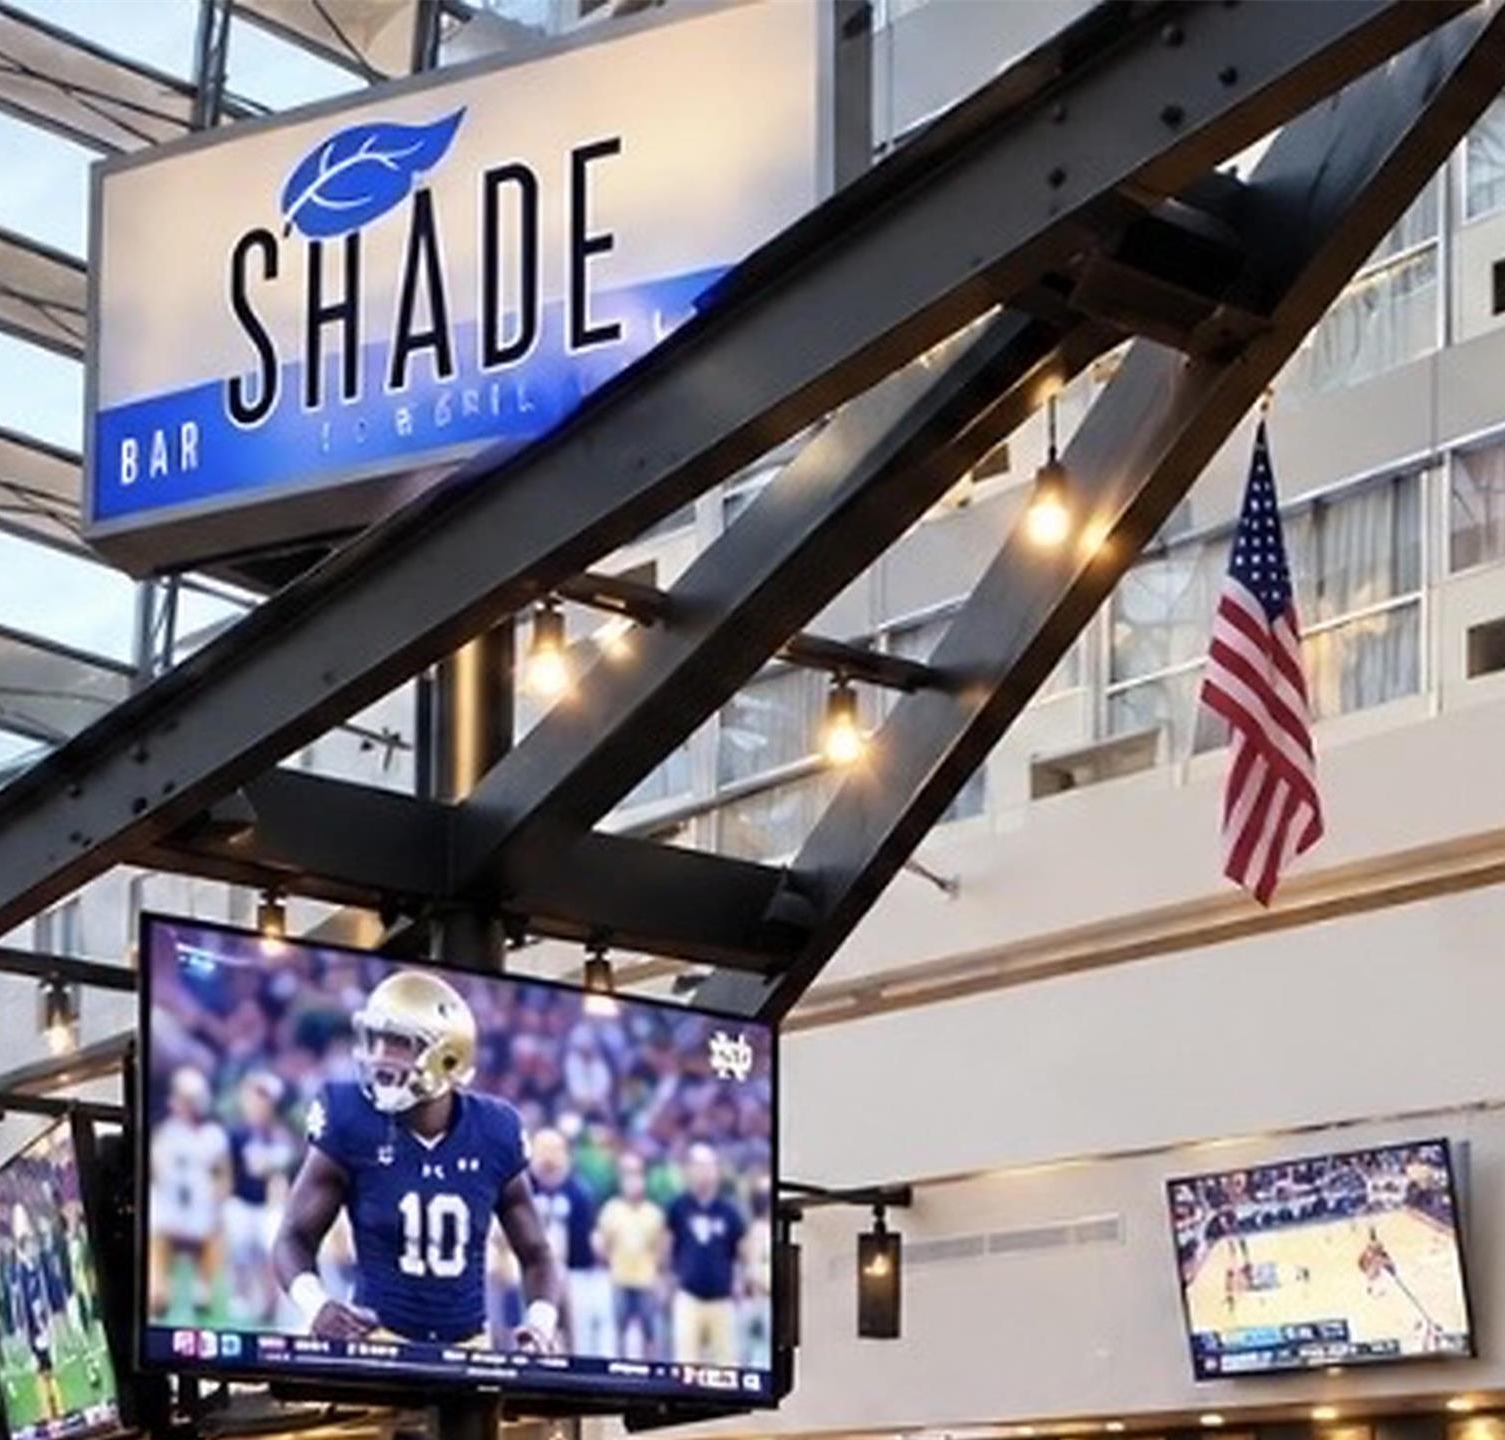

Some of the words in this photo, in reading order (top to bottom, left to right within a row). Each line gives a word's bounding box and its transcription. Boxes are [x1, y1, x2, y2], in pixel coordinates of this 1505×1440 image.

[228, 137, 621, 424] SHADE
[121, 421, 199, 484] BAR
[398, 1191, 470, 1277] 10
